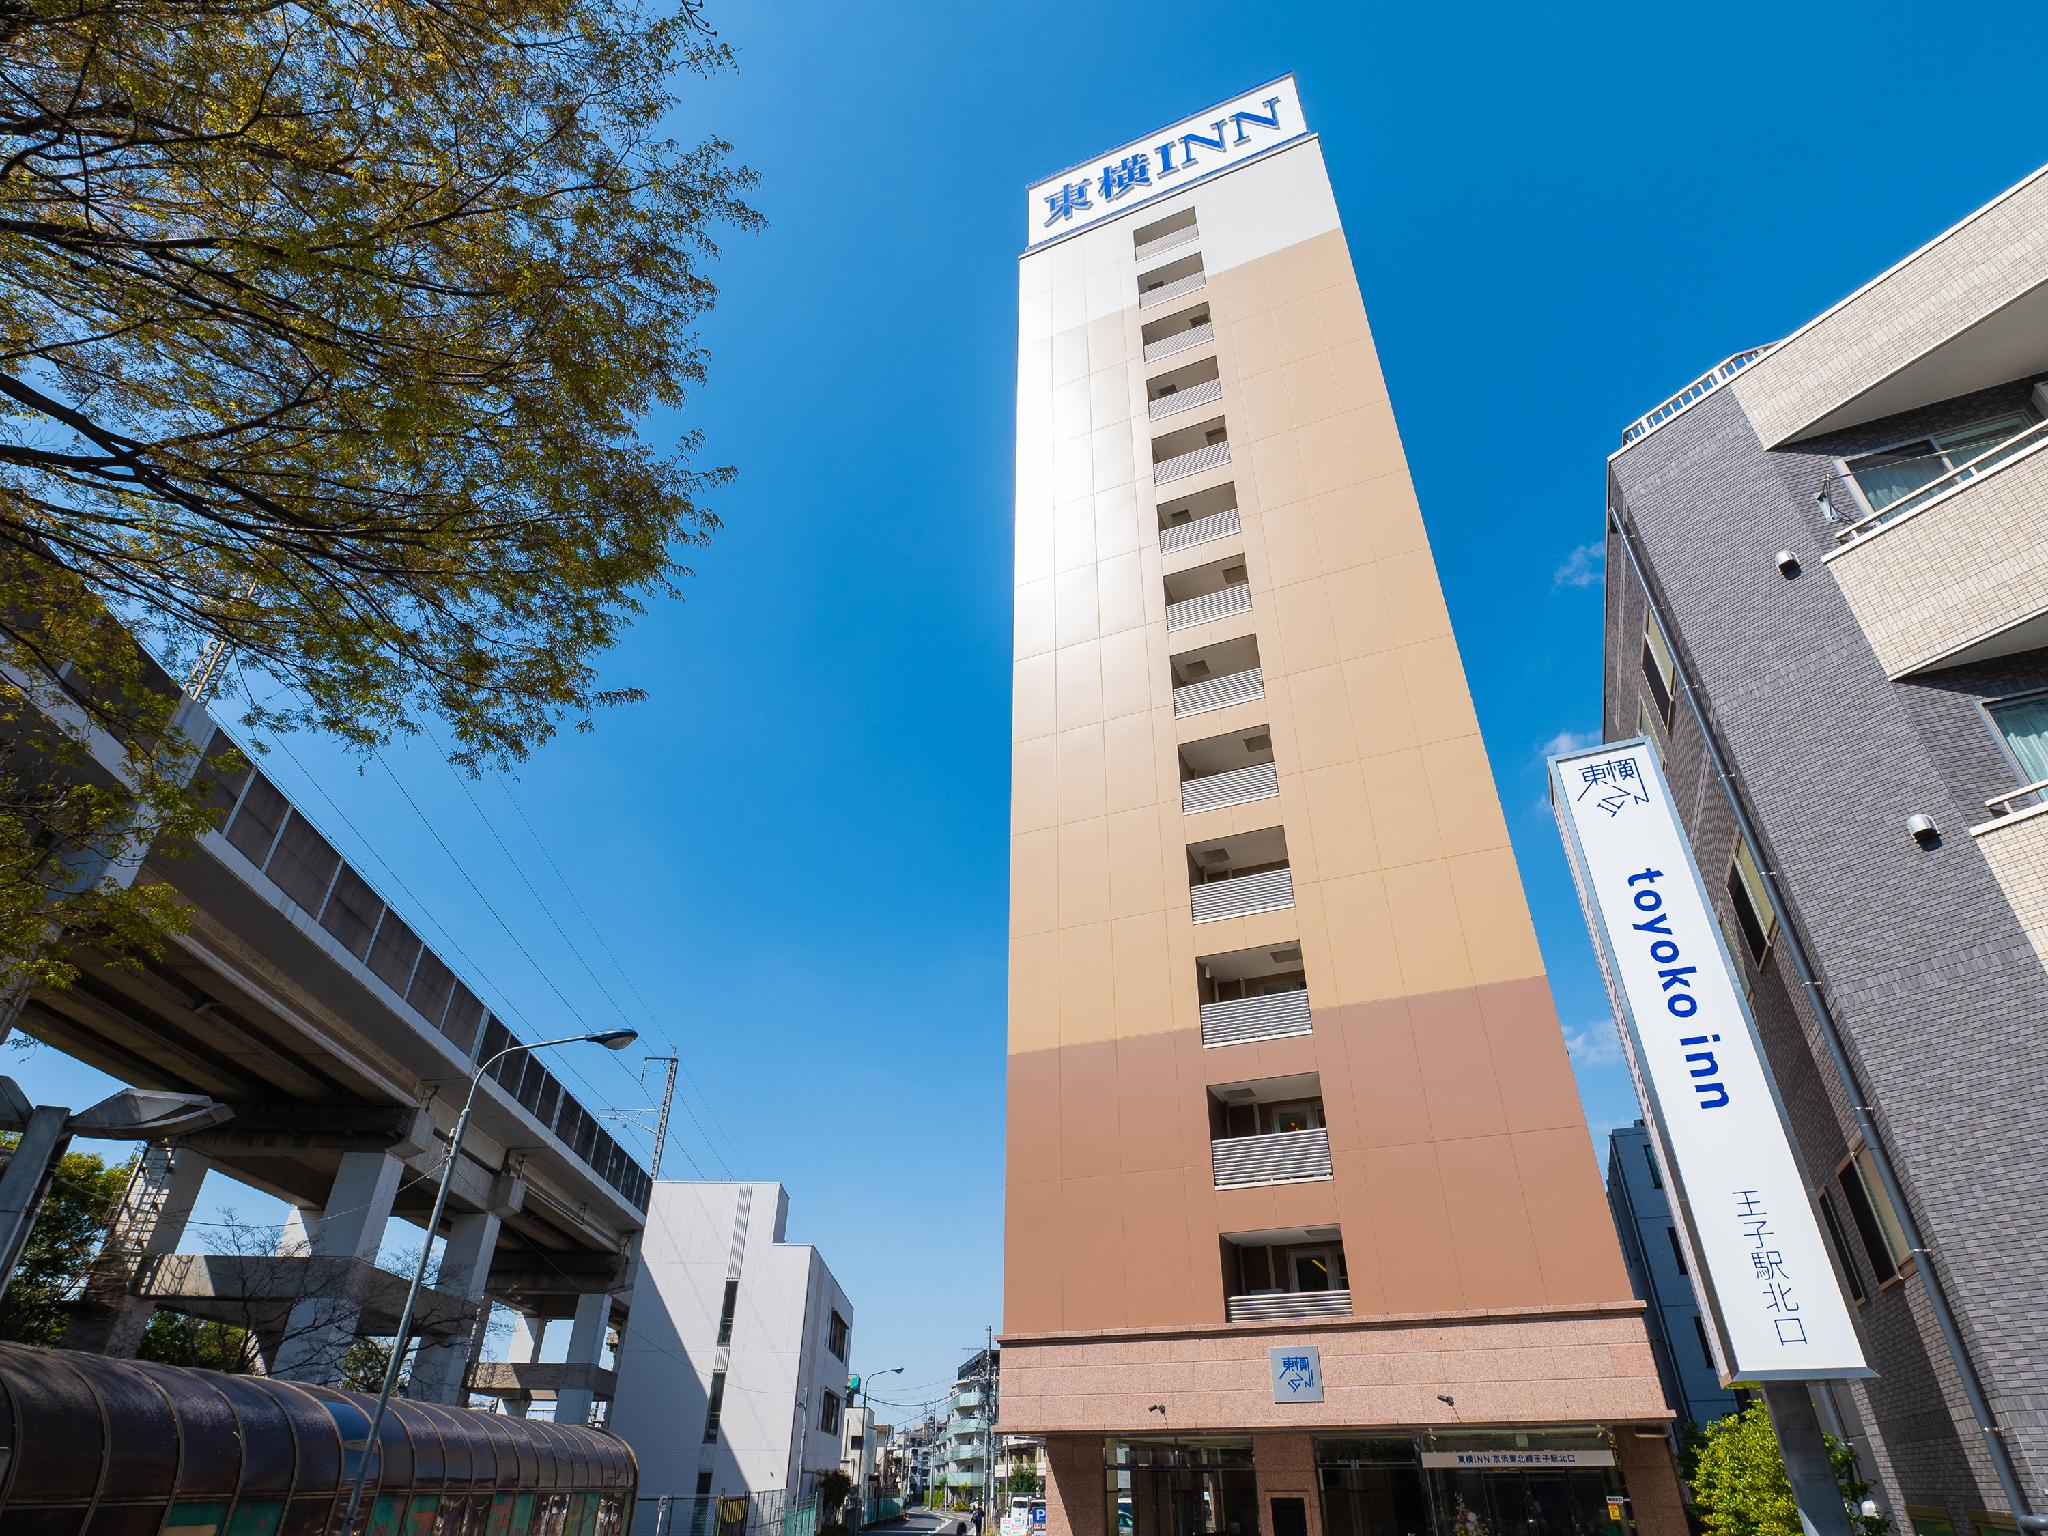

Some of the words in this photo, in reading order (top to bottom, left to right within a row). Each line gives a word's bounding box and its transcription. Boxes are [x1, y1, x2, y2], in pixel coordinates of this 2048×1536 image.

[1043, 96, 1281, 228] 東横INN
[1627, 867, 1698, 1018] toyoko
[1679, 1033, 1730, 1110] inn
[1732, 1190, 1808, 1346] 王子駅北口
[1036, 1509, 1046, 1521] P
